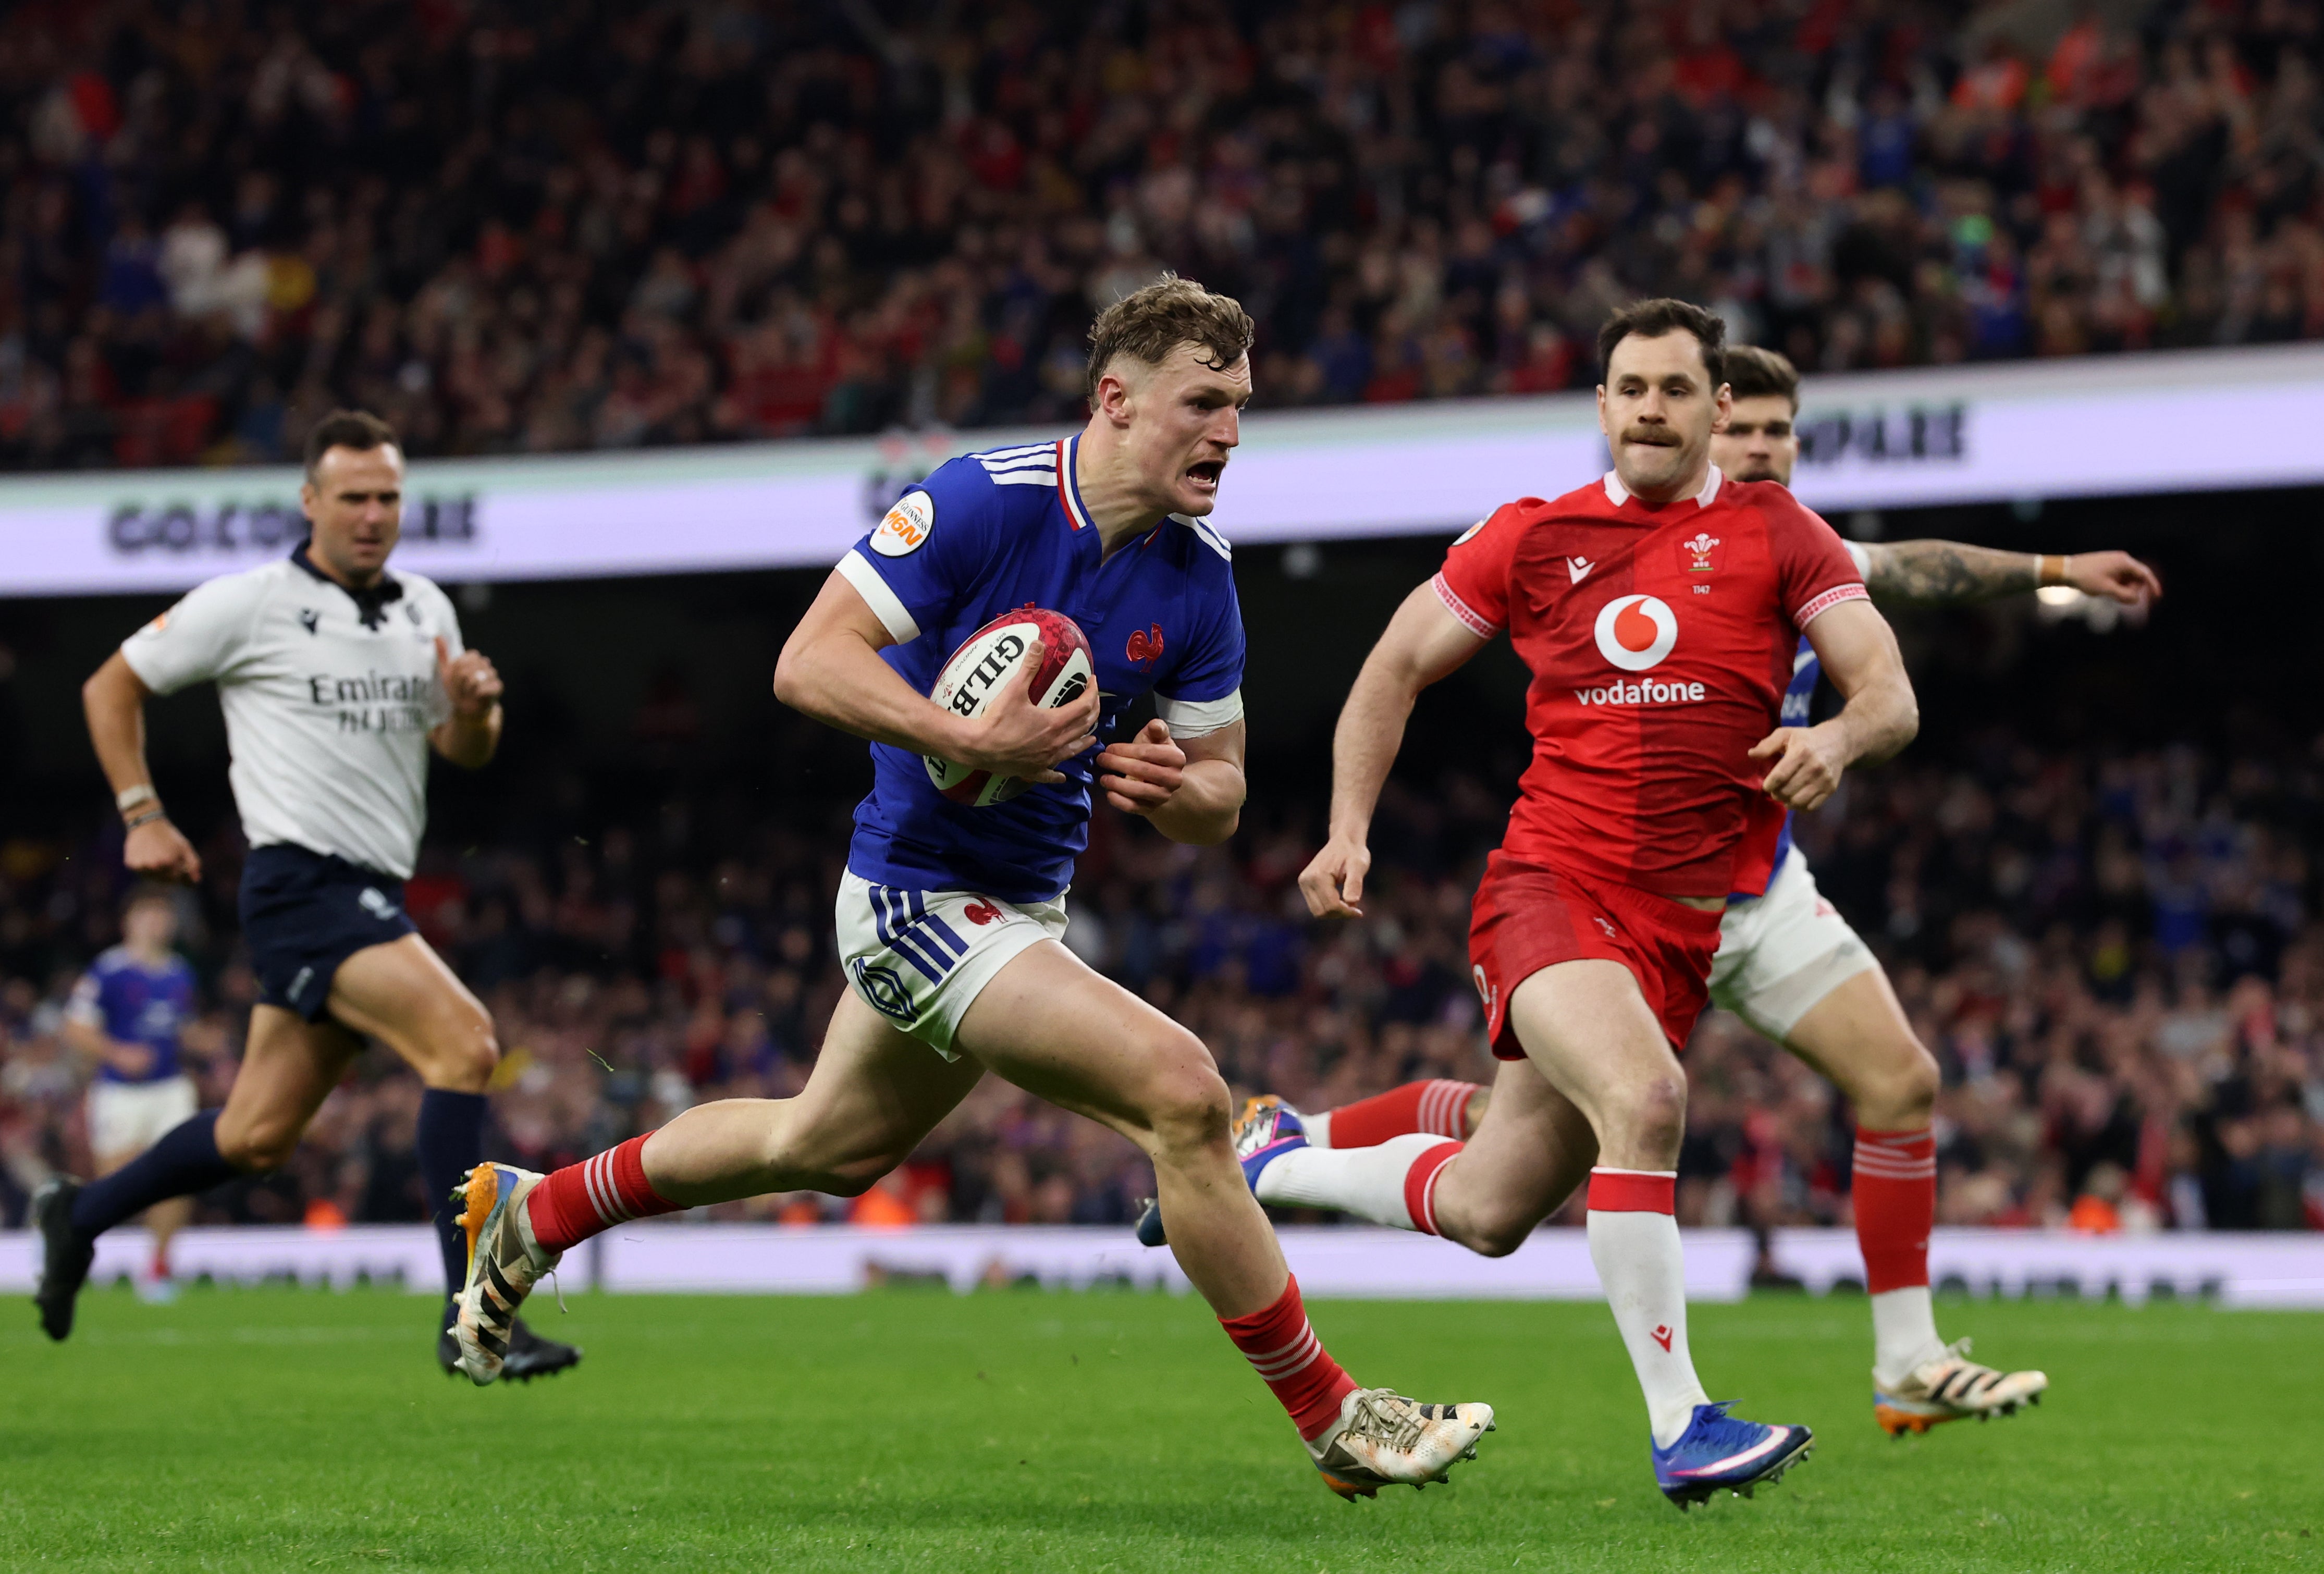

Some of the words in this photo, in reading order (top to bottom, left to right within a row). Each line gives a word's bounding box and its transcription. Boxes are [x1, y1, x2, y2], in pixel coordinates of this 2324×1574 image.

[900, 502, 929, 532] GUINNESS
[996, 632, 1006, 642] SIZE
[1573, 677, 1706, 706] vodafone
